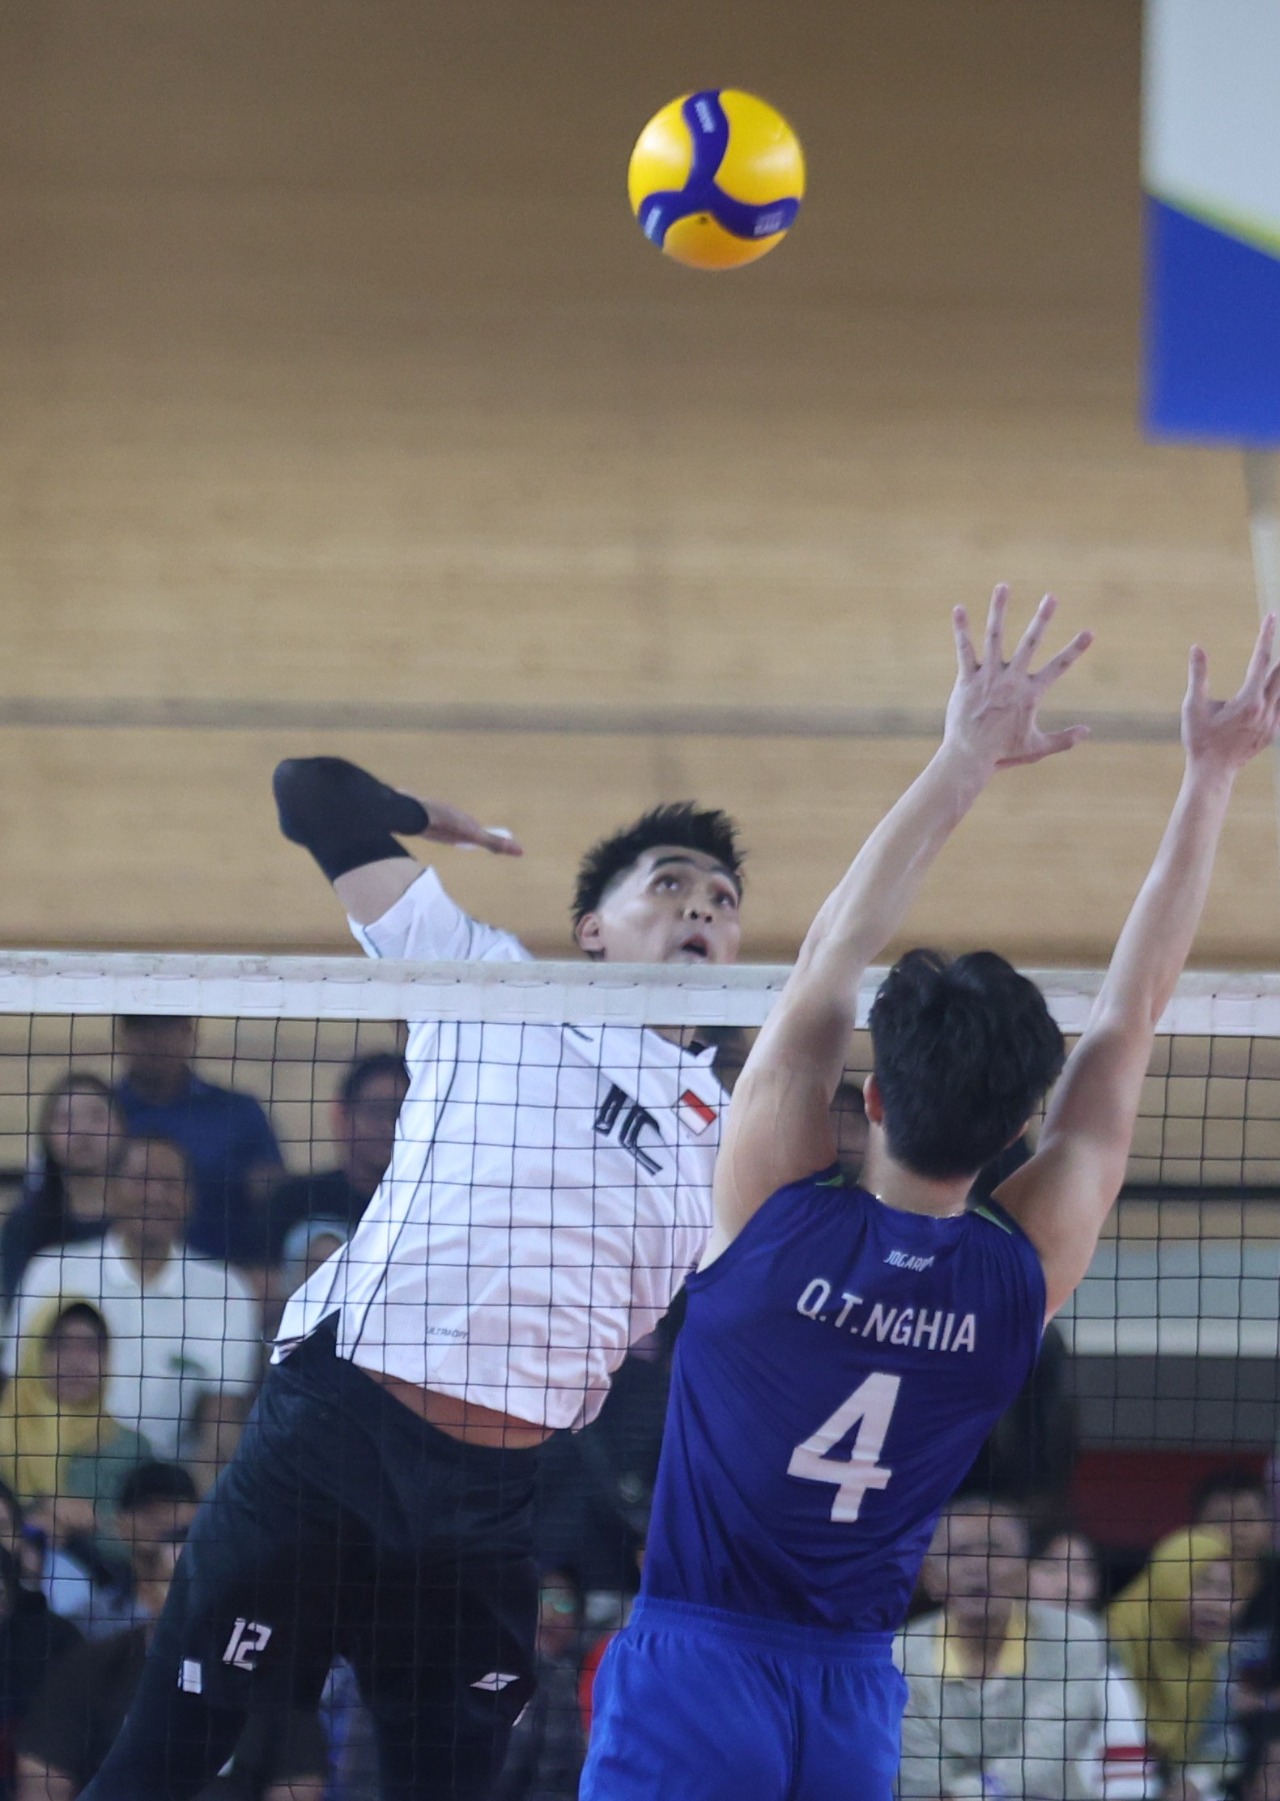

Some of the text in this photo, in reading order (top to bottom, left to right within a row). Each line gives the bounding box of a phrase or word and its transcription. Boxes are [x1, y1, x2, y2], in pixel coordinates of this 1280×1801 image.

[796, 1278, 976, 1353] Q.T.NGHIA
[787, 1371, 901, 1523] 4
[222, 1617, 272, 1672] 12
